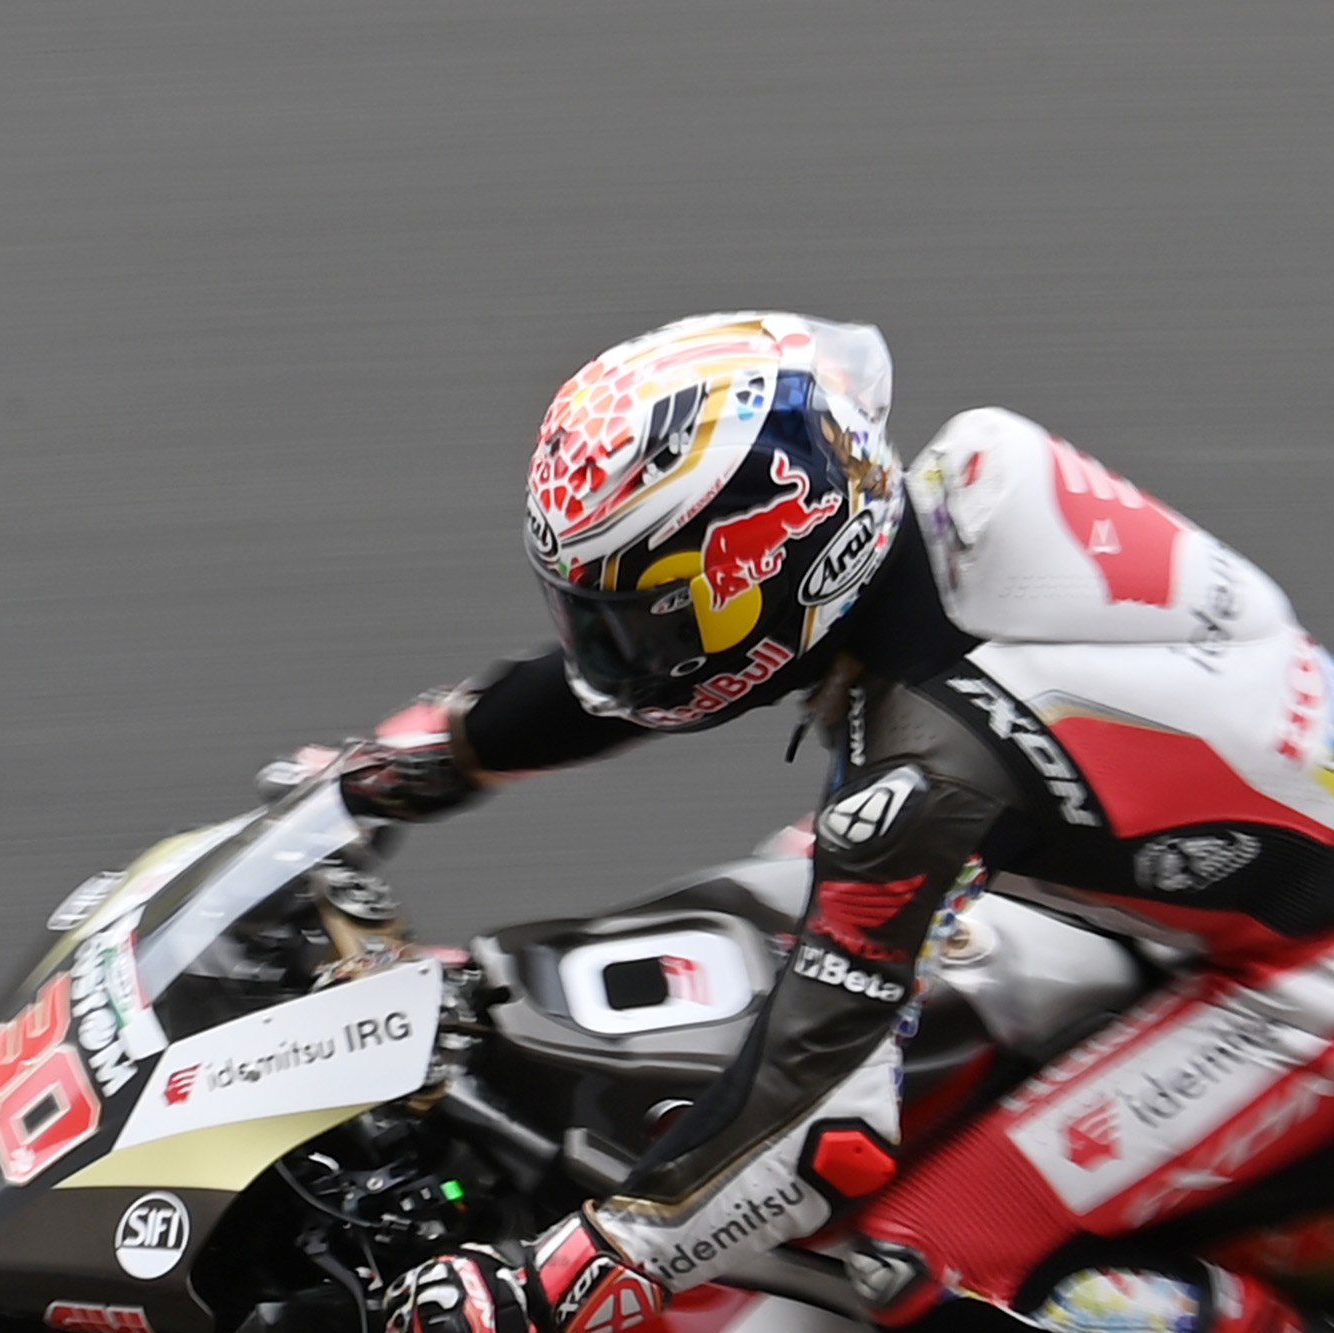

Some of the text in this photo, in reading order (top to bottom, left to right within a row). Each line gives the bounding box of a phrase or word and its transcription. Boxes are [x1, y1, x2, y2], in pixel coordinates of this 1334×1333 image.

[812, 520, 873, 597] Arai
[945, 678, 1102, 827] IXON
[817, 952, 905, 1002] Beta
[204, 1011, 414, 1093] idemitsu IRG
[122, 1206, 180, 1249] SIFI
[651, 1181, 805, 1280] idemitsu
